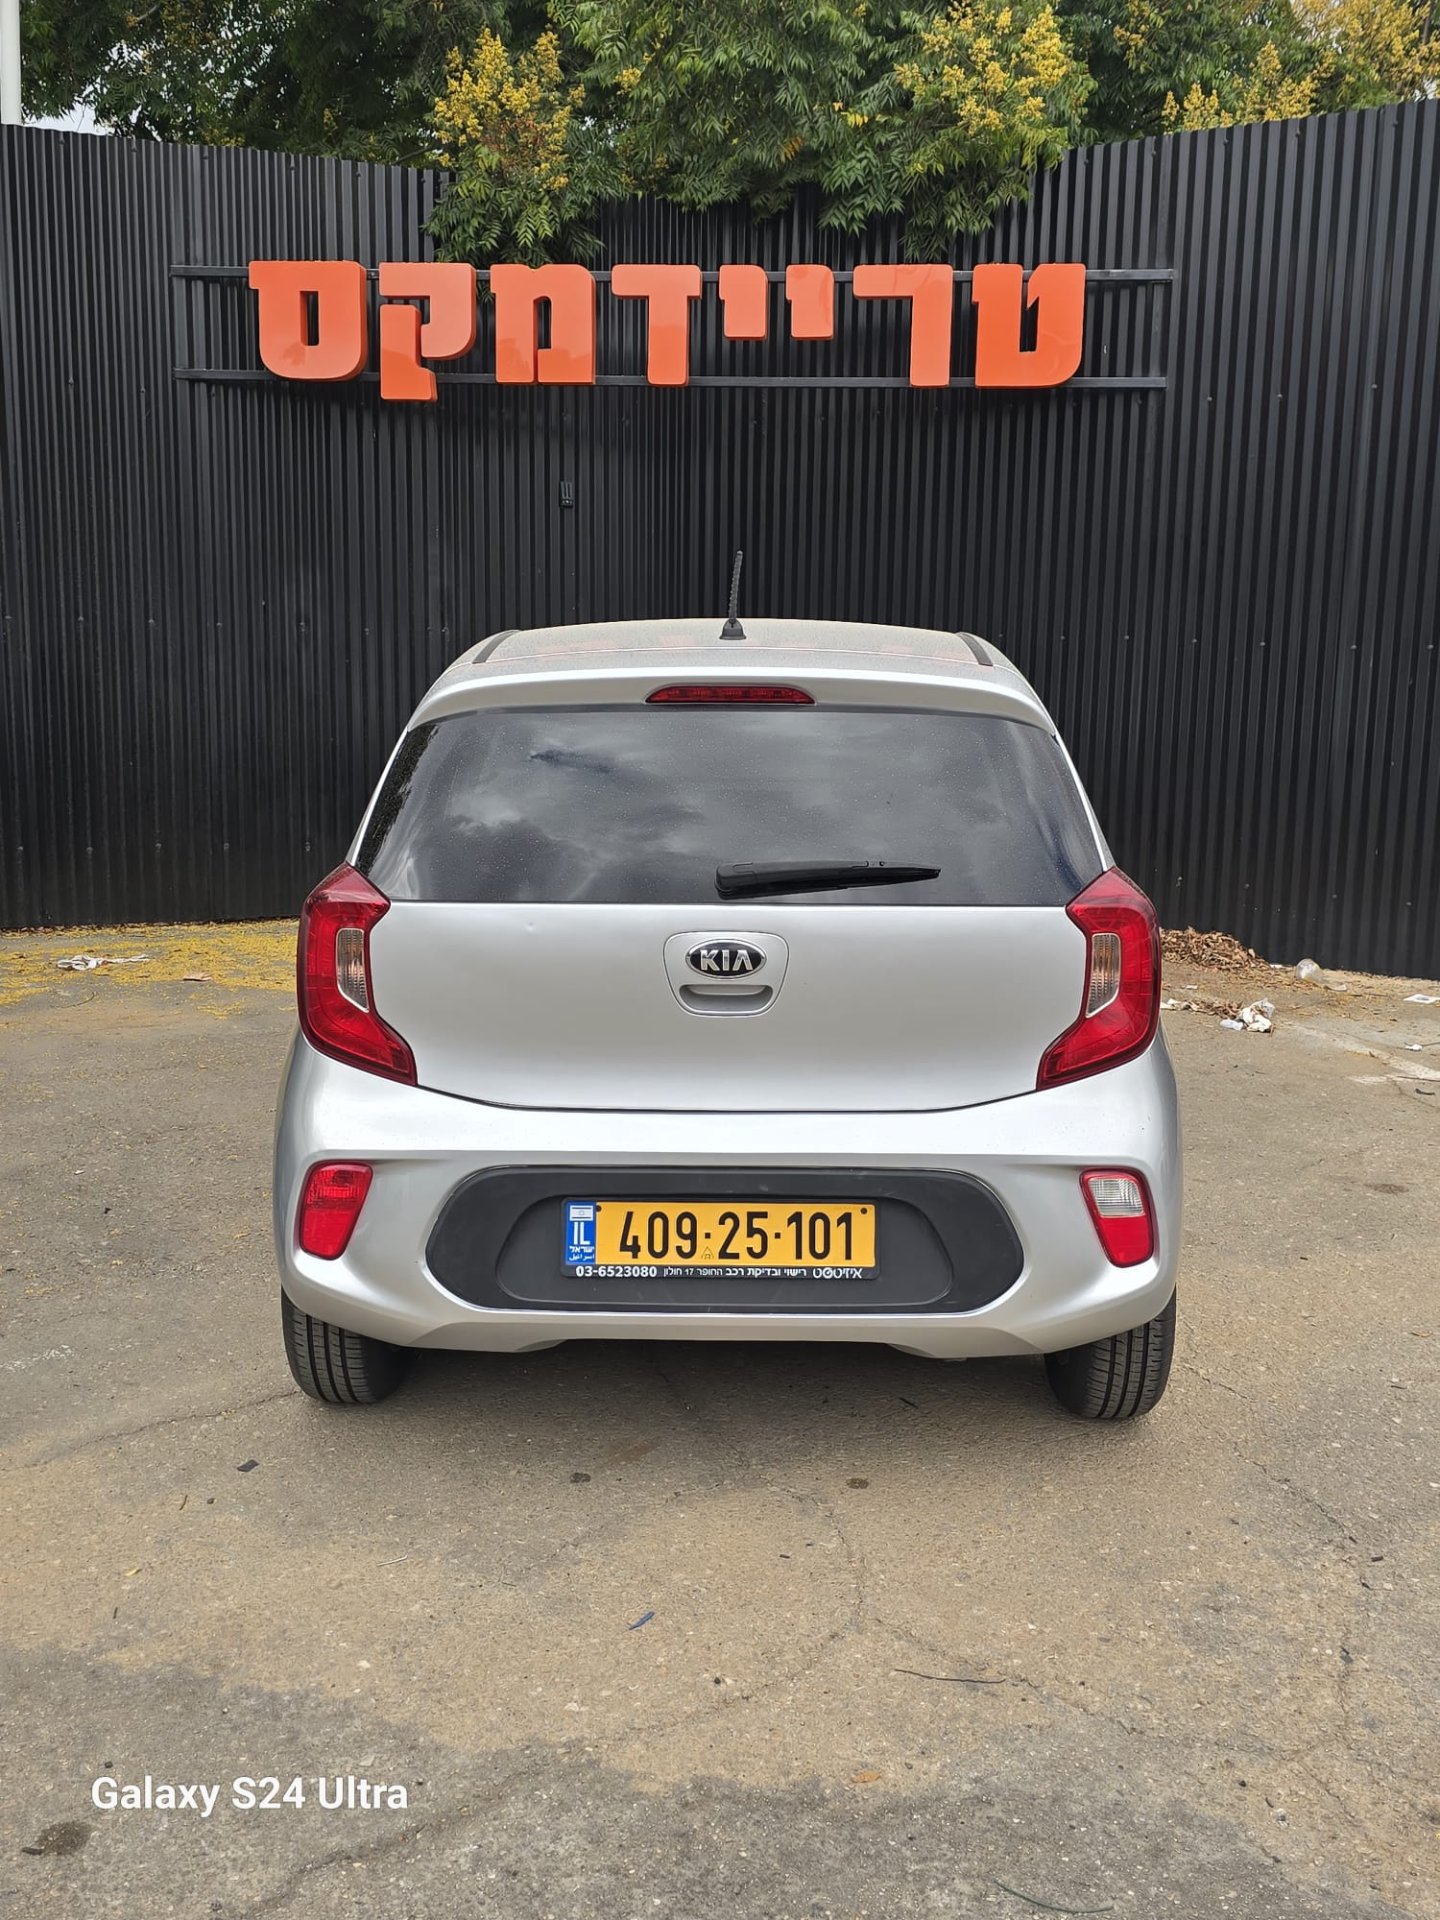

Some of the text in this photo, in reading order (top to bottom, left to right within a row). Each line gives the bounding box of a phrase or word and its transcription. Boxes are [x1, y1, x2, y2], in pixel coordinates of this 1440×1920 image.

[248, 260, 1087, 402] טריידמקס
[700, 949, 753, 971] KIA
[573, 1221, 591, 1245] IL
[575, 1265, 657, 1277] 03-6523080
[684, 1267, 694, 1276] 17
[725, 1267, 744, 1276] רכב
[746, 1267, 781, 1278] ובדיקת
[783, 1268, 807, 1277] רישוי
